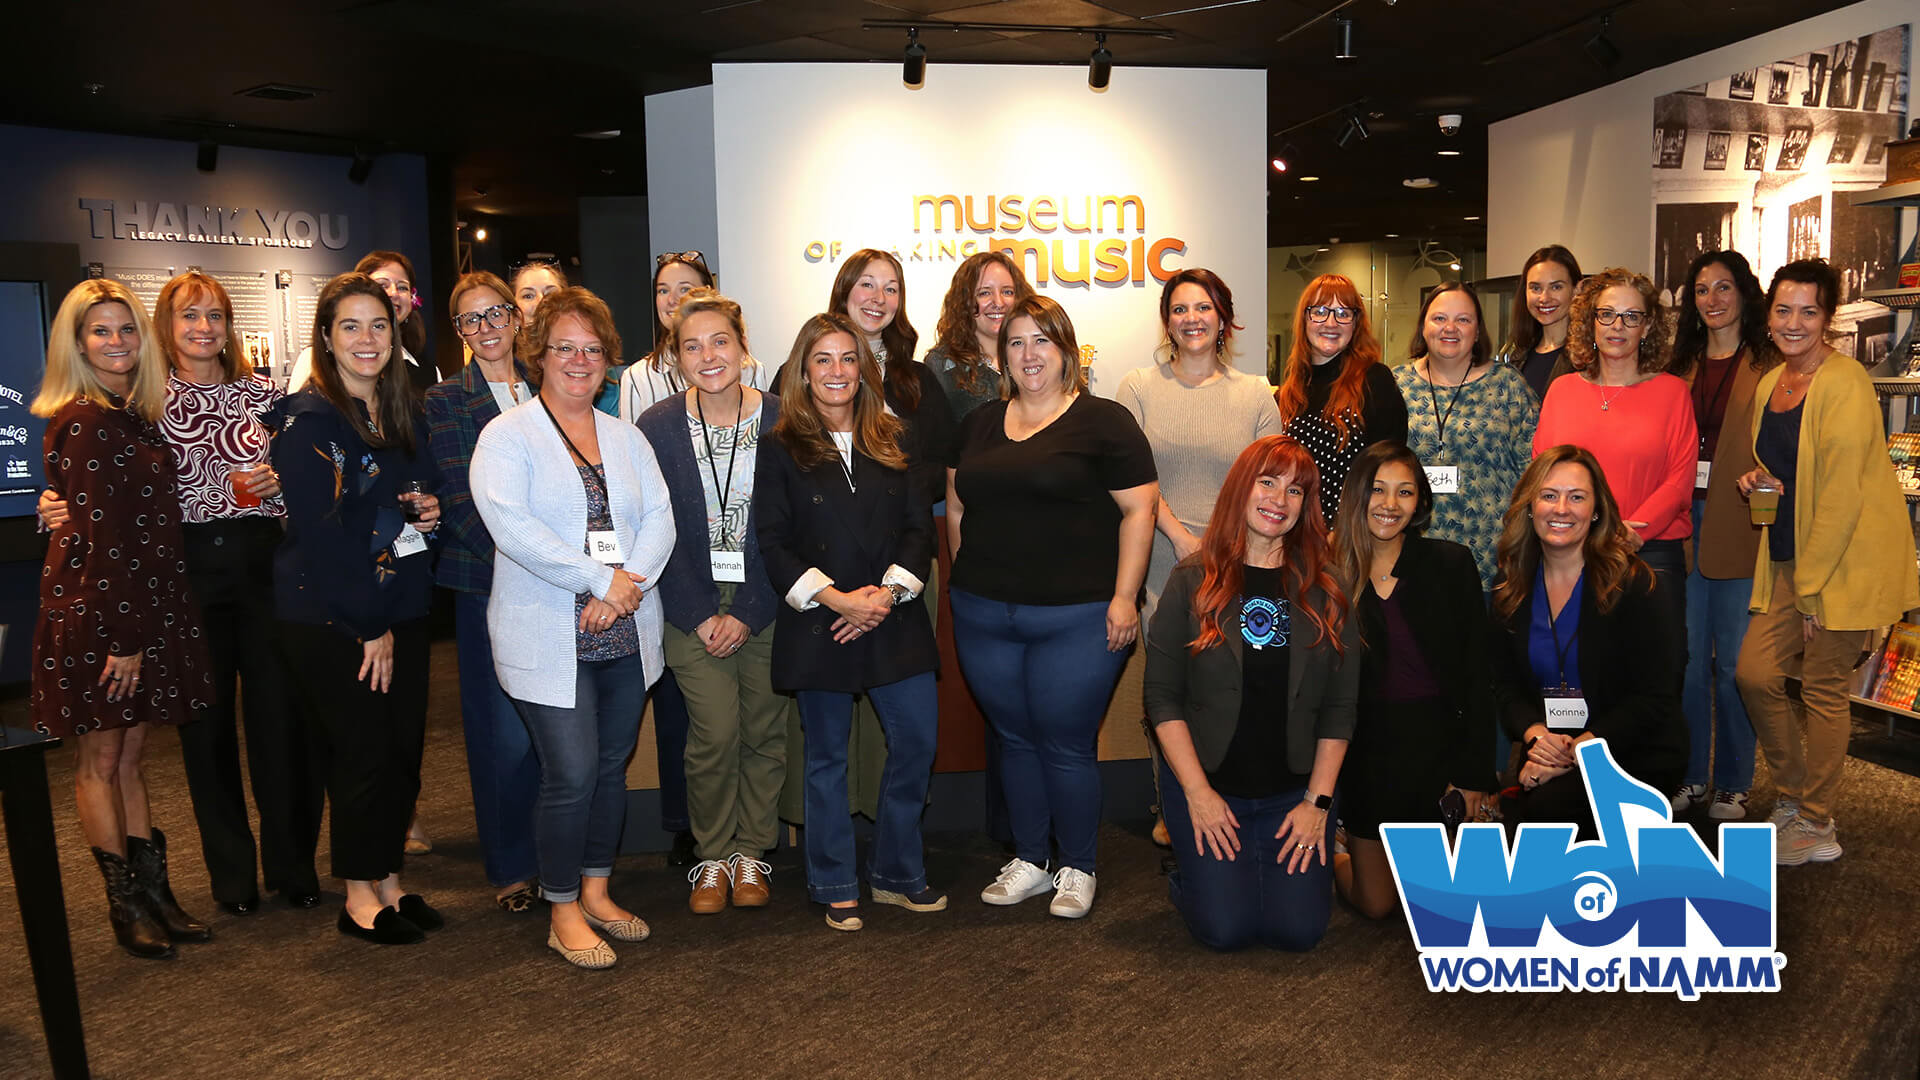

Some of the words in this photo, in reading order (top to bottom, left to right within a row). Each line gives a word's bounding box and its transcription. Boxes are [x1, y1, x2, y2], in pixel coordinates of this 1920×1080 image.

[79, 198, 245, 240] THANK
[256, 209, 350, 251] YOU
[913, 194, 1145, 234] museum
[131, 231, 182, 242] LEGACY
[188, 233, 244, 245] GALLERY
[248, 236, 313, 248] SPONSORS
[804, 240, 843, 263] OF
[989, 236, 1188, 291] music
[597, 540, 616, 552] Bev
[1549, 708, 1586, 717] Korinne
